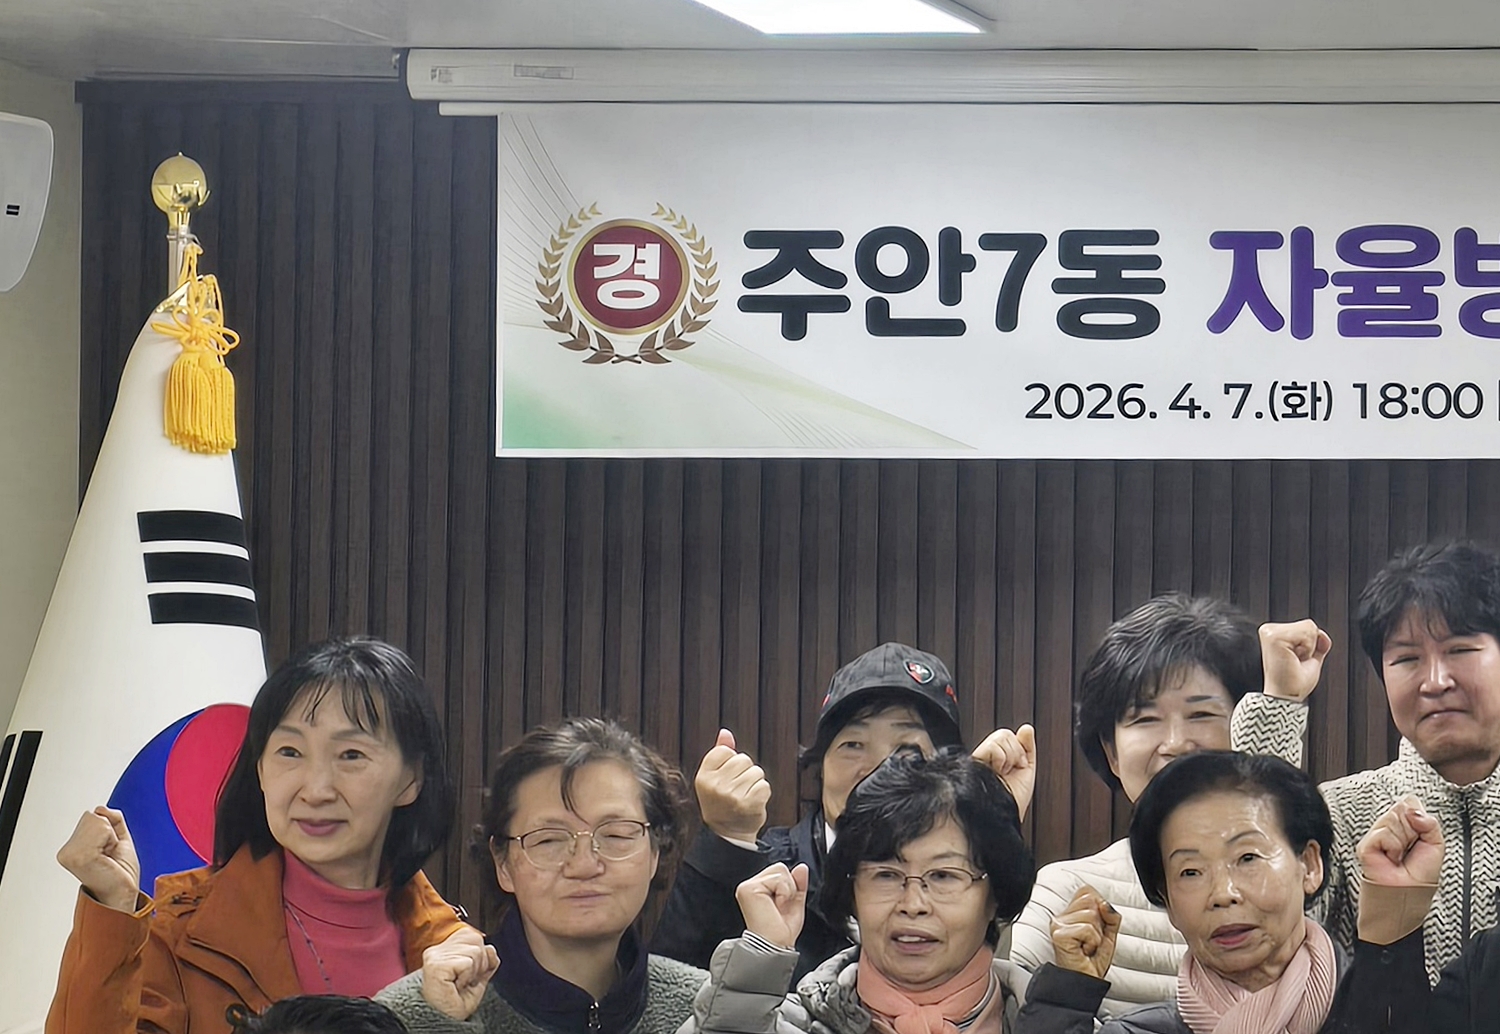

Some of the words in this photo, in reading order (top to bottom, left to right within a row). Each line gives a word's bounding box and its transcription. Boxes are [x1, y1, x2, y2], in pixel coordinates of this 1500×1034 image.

[592, 241, 664, 311] 경
[736, 225, 1167, 342] 주안7동
[1024, 382, 1158, 420] 2026.
[1168, 382, 1211, 420] 4.
[1223, 380, 1333, 422] 7.(화)
[1352, 382, 1484, 420] 18:00
